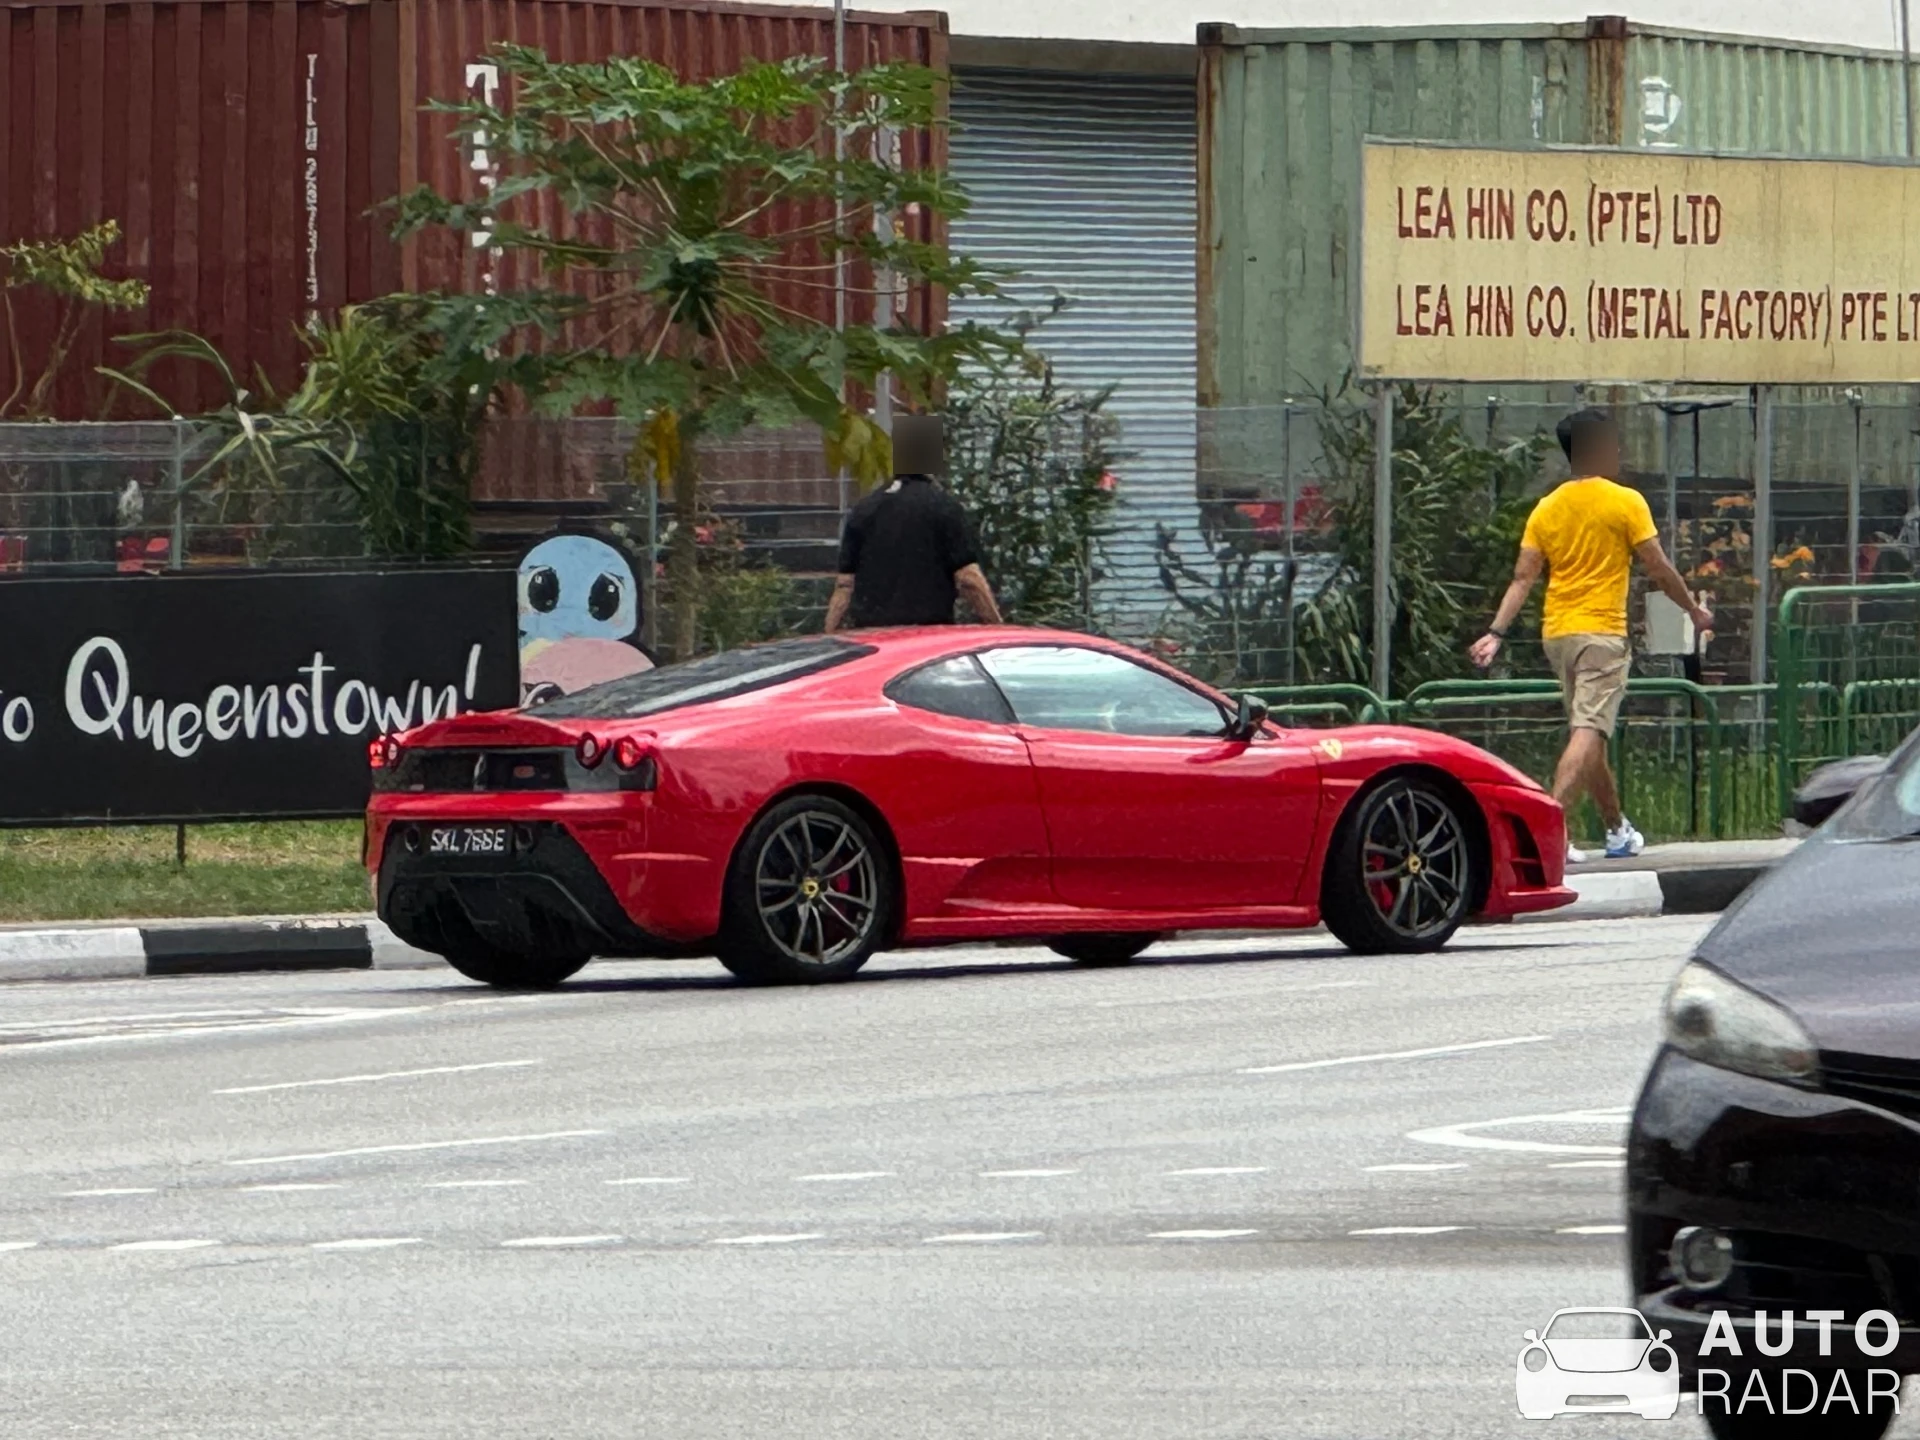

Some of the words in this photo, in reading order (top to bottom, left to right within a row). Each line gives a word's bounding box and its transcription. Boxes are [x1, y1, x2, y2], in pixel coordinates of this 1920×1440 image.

[1397, 185, 1455, 239] LEA
[1467, 187, 1515, 241] HIN
[1526, 188, 1576, 242] CO.
[1587, 182, 1661, 250] (PTE)
[1672, 194, 1722, 245] LTD
[1396, 284, 1454, 337] LEA
[1465, 285, 1514, 338] HIN
[1526, 286, 1576, 339] CO.
[1587, 280, 1690, 343] (METAL
[1700, 283, 1832, 348] FACTORY)
[1841, 292, 1888, 341] PTE
[0, 689, 34, 742] o
[65, 636, 482, 757] Queenstown!
